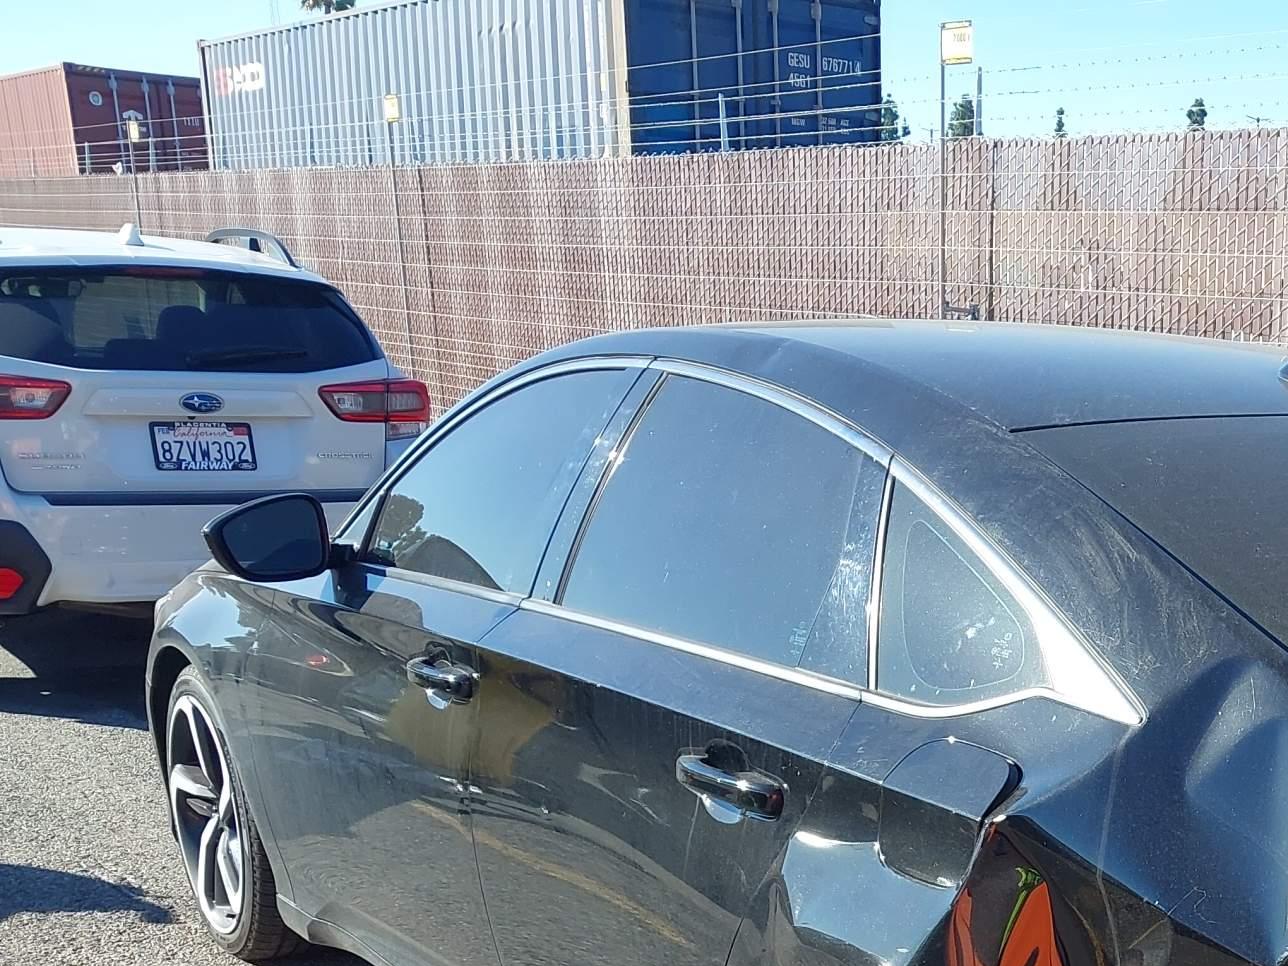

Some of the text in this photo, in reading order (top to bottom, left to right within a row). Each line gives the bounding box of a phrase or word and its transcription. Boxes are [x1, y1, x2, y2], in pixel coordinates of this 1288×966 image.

[788, 52, 810, 69] GESU
[788, 72, 810, 88] 45G1
[161, 440, 250, 462] 8ZVW302
[181, 461, 235, 470] FAIRWAY
